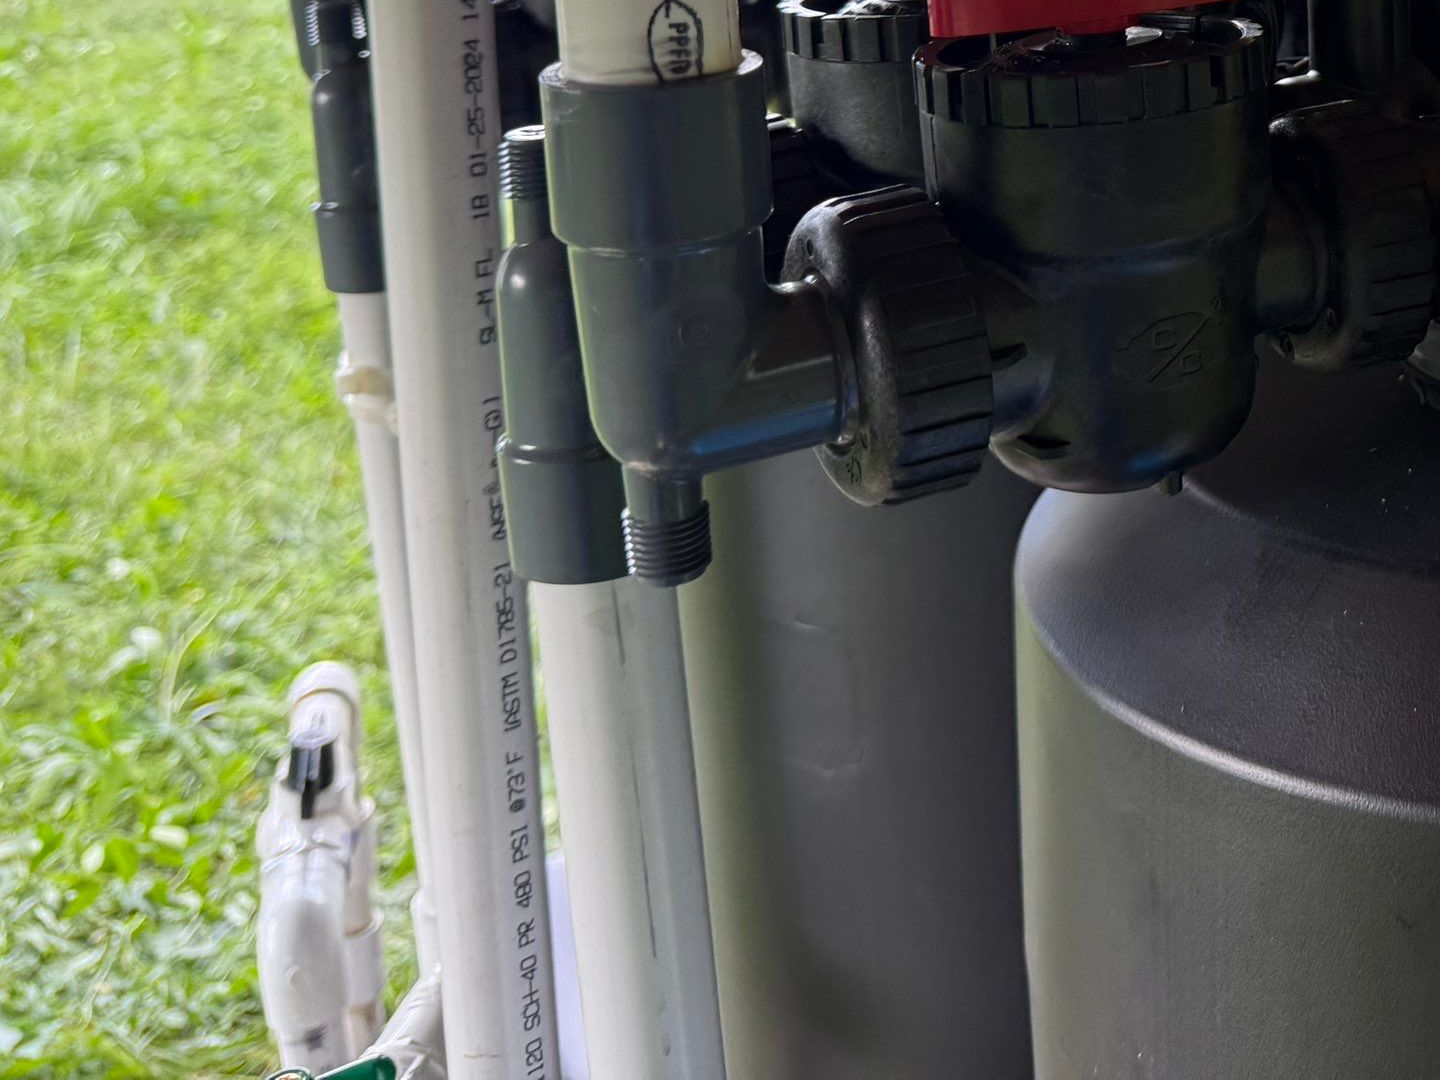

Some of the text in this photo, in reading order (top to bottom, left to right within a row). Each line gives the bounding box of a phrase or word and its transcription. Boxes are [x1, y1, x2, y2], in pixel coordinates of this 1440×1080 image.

[463, 39, 488, 178] 01-25-2024
[510, 824, 530, 863] PSI
[513, 870, 532, 907] 480
[517, 917, 536, 948] PR
[520, 954, 541, 1031] SCH-40
